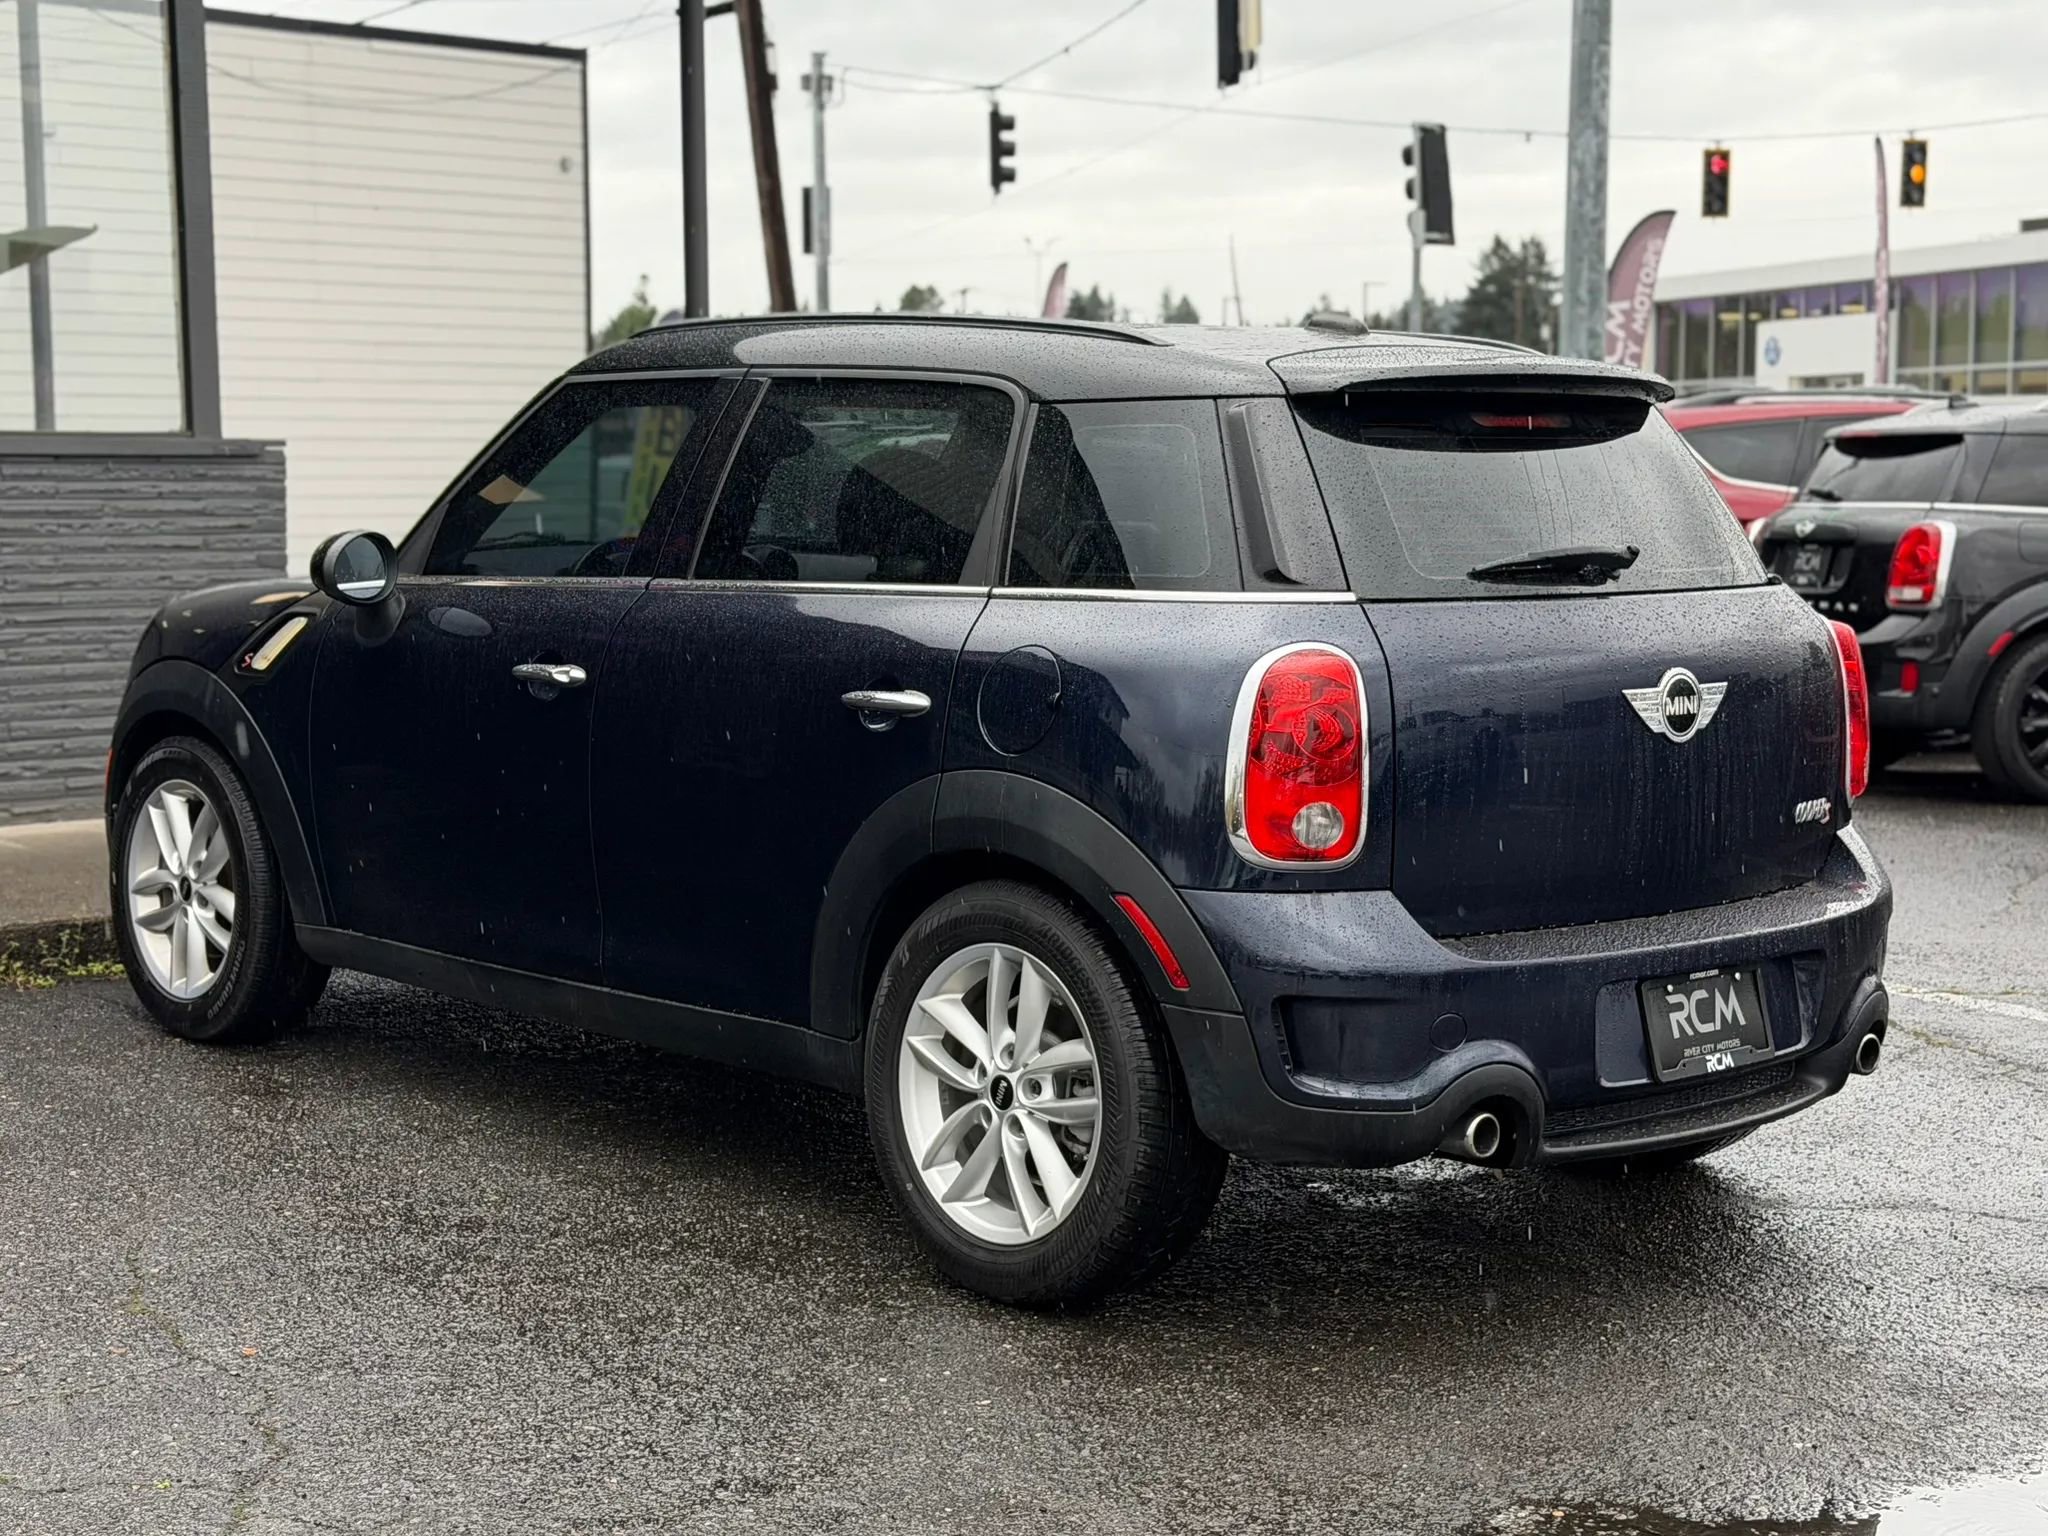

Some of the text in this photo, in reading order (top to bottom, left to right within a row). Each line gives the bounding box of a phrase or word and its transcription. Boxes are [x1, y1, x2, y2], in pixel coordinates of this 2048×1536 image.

[1631, 237, 1663, 335] MOTORS
[1665, 696, 1698, 716] MINI
[1665, 984, 1746, 1039] RCM
[1683, 1038, 1741, 1057] RIVER CITY MOTORS
[1705, 1052, 1735, 1073] RCM
[995, 1080, 1008, 1106] MINI
